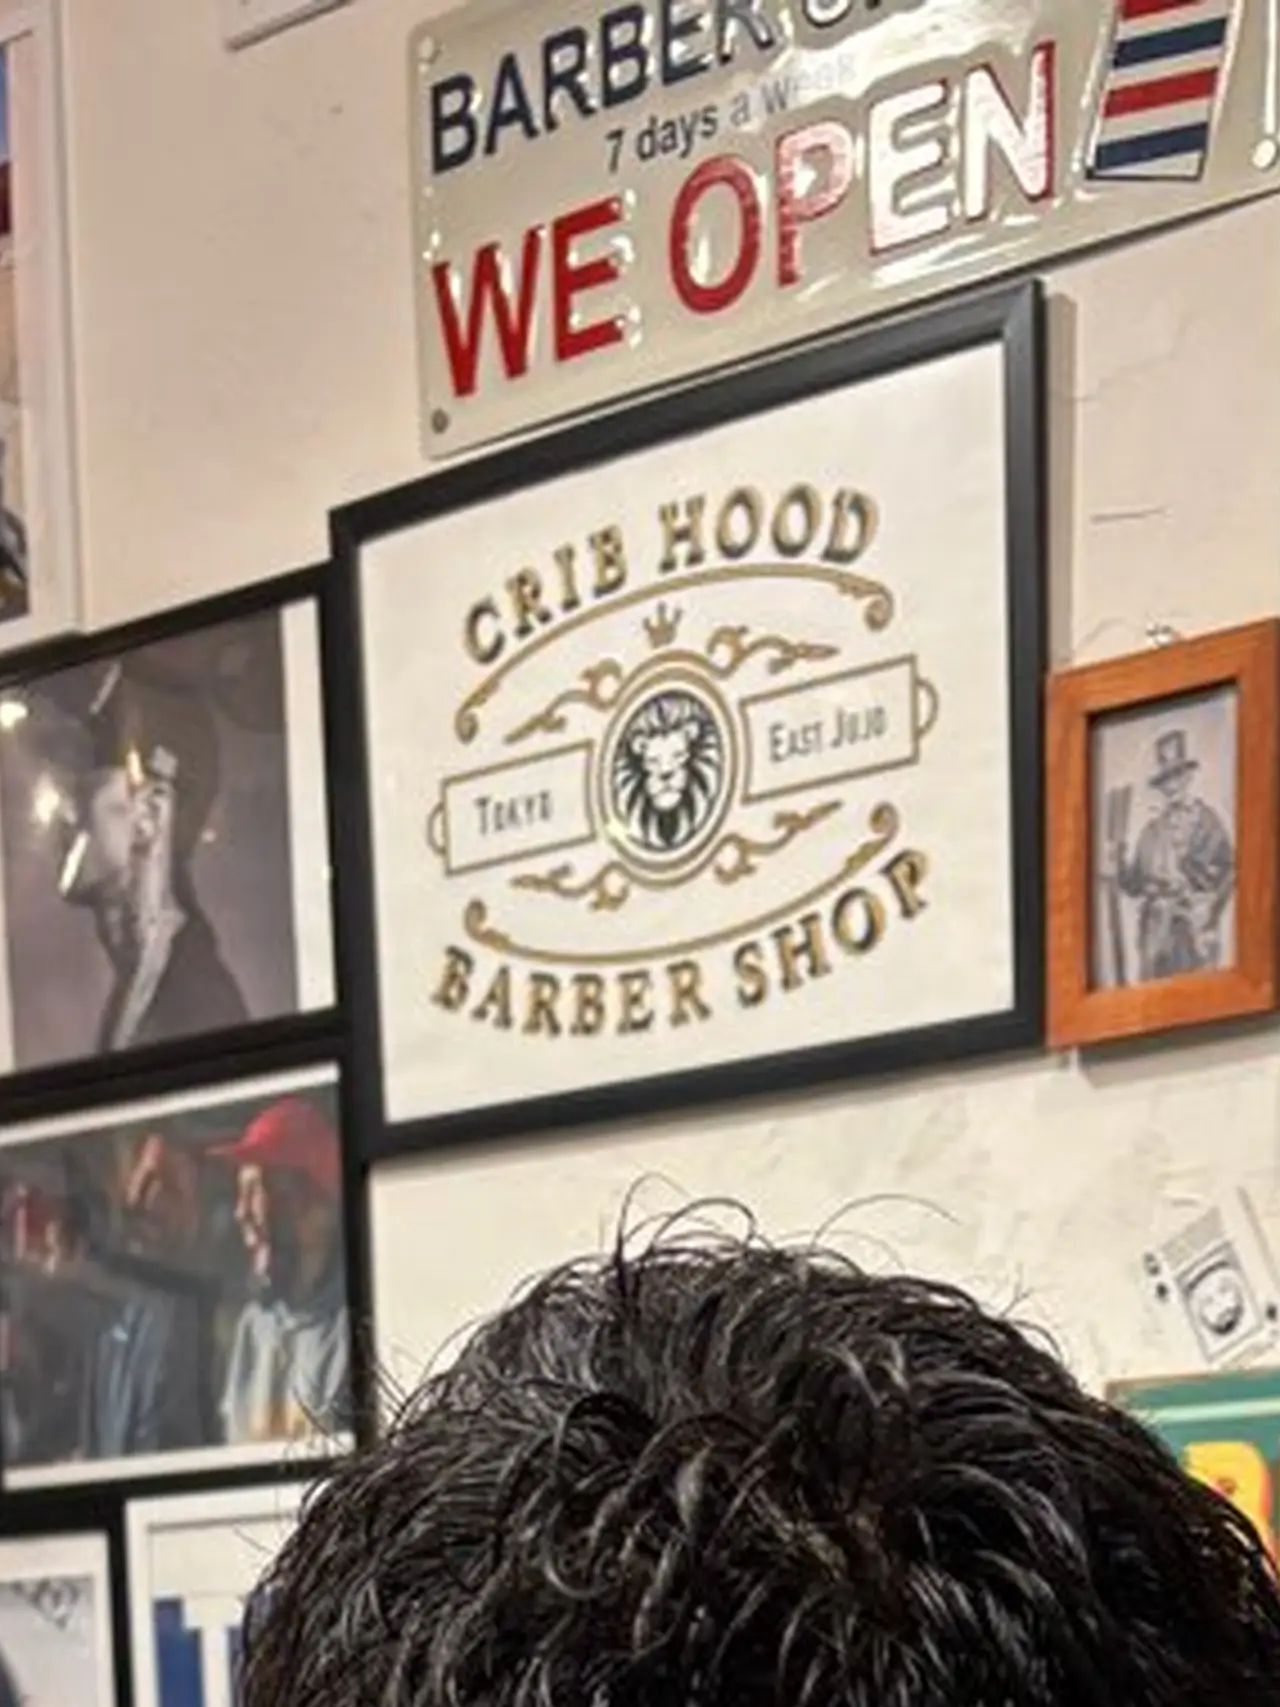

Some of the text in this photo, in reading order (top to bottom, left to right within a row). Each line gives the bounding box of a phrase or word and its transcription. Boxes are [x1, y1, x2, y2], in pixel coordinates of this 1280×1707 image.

[431, 42, 1055, 399] WE OPEN
[605, 129, 625, 174] 7
[637, 102, 719, 163] days
[730, 90, 752, 126] a
[463, 484, 879, 664] CRIB HOOD
[430, 847, 931, 1037] BARBER SHOP
